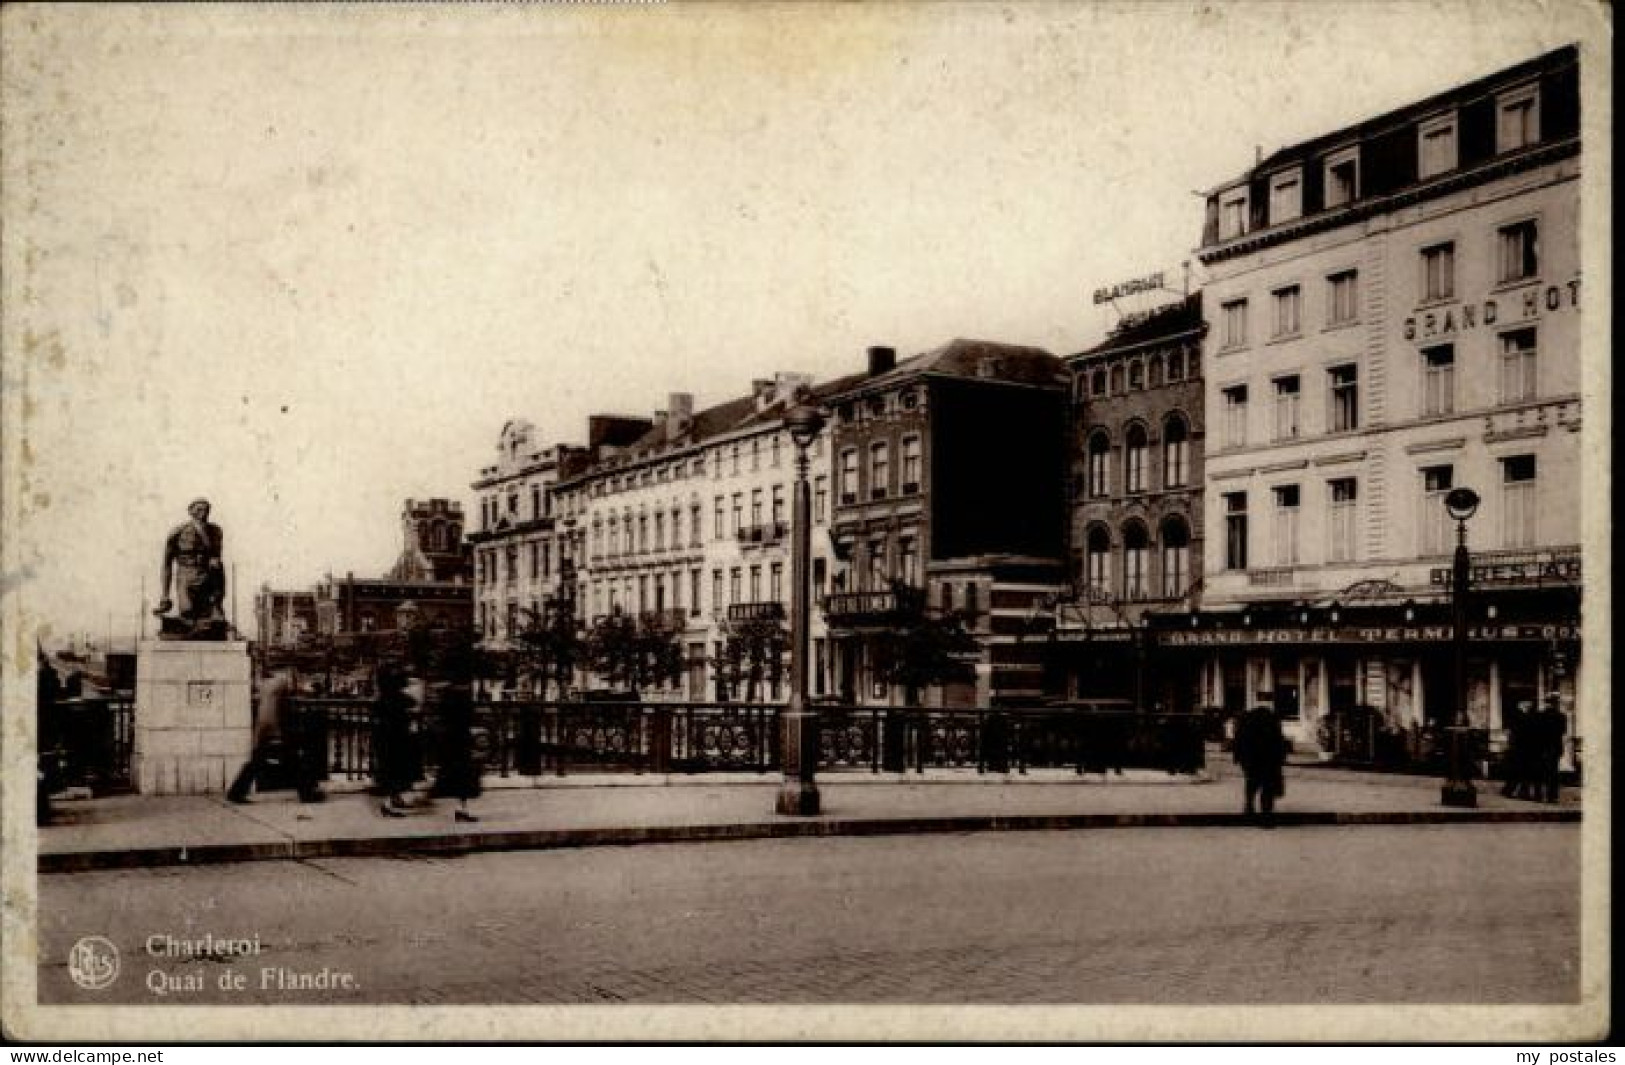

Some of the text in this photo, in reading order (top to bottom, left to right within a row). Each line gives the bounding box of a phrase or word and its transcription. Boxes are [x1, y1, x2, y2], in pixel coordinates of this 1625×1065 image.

[1404, 301, 1497, 341] GRAND
[1170, 630, 1241, 645] GRAND
[1257, 629, 1338, 642] HOTEL
[1359, 626, 1518, 642] TERMIUS
